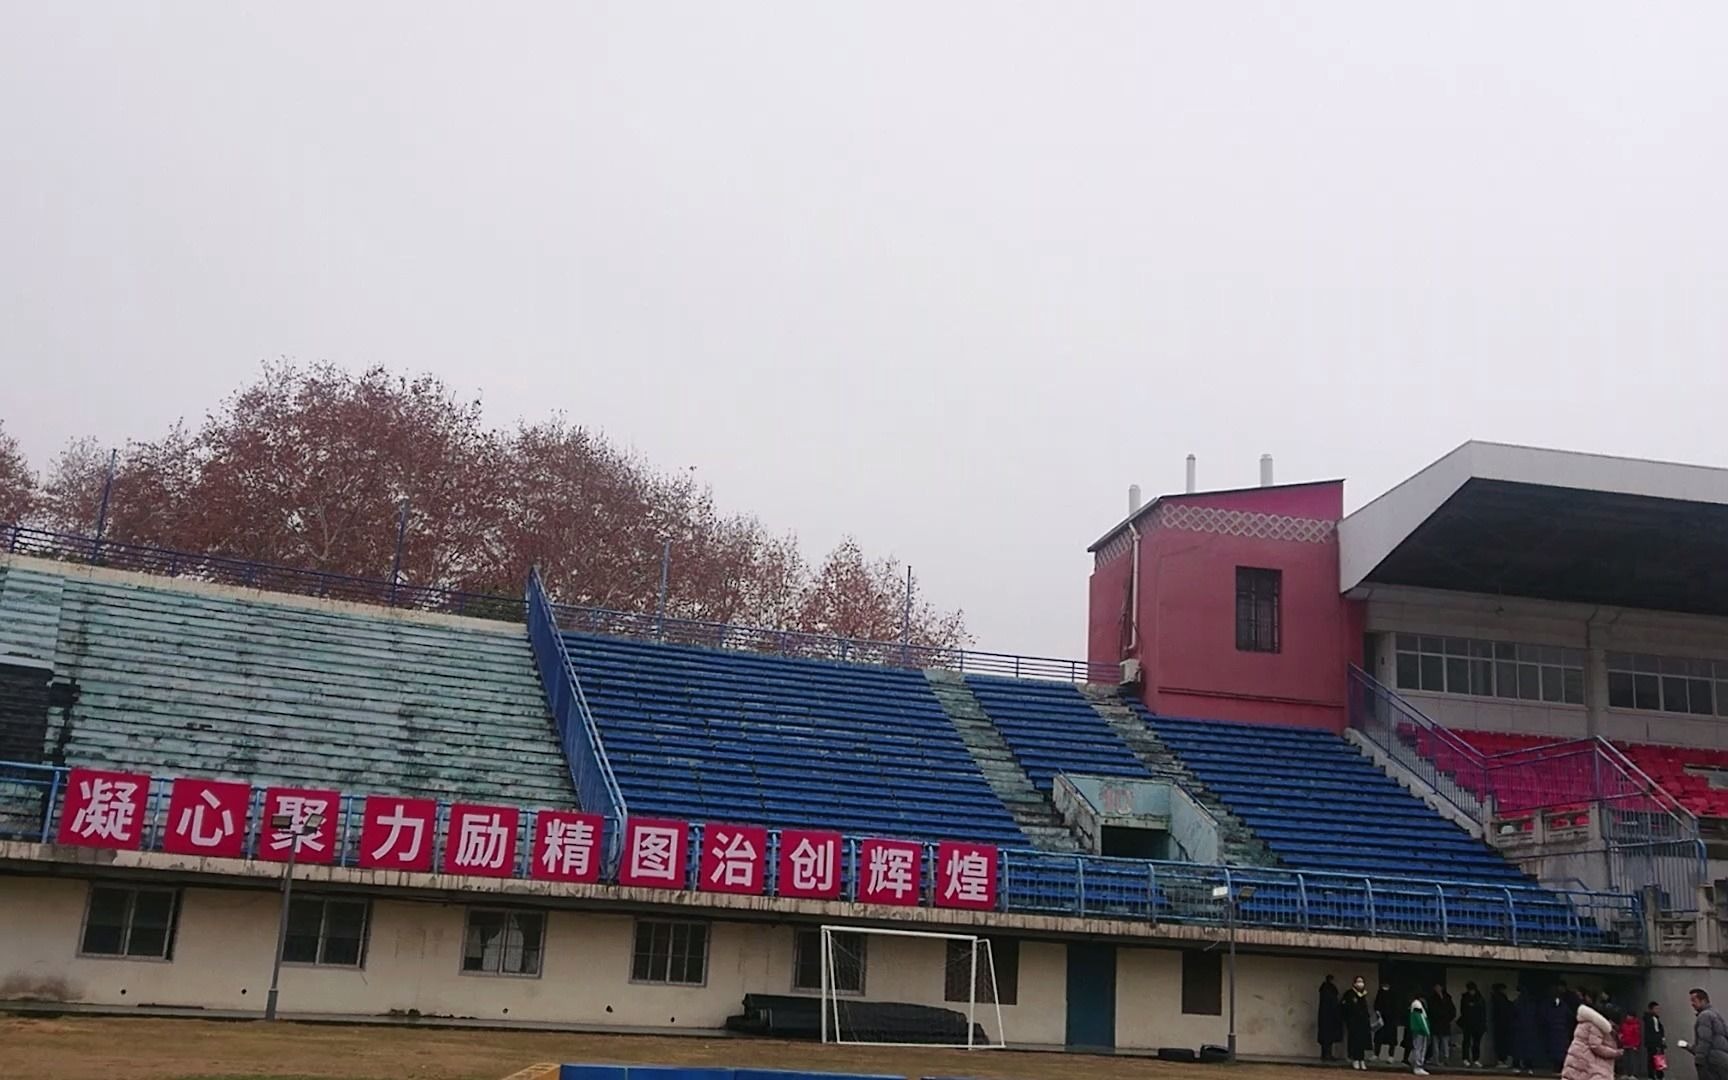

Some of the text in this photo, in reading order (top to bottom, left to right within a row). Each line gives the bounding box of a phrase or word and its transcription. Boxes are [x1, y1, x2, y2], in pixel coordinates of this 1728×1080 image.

[70, 778, 988, 902] 凝心聚力励精图治创辉煌
